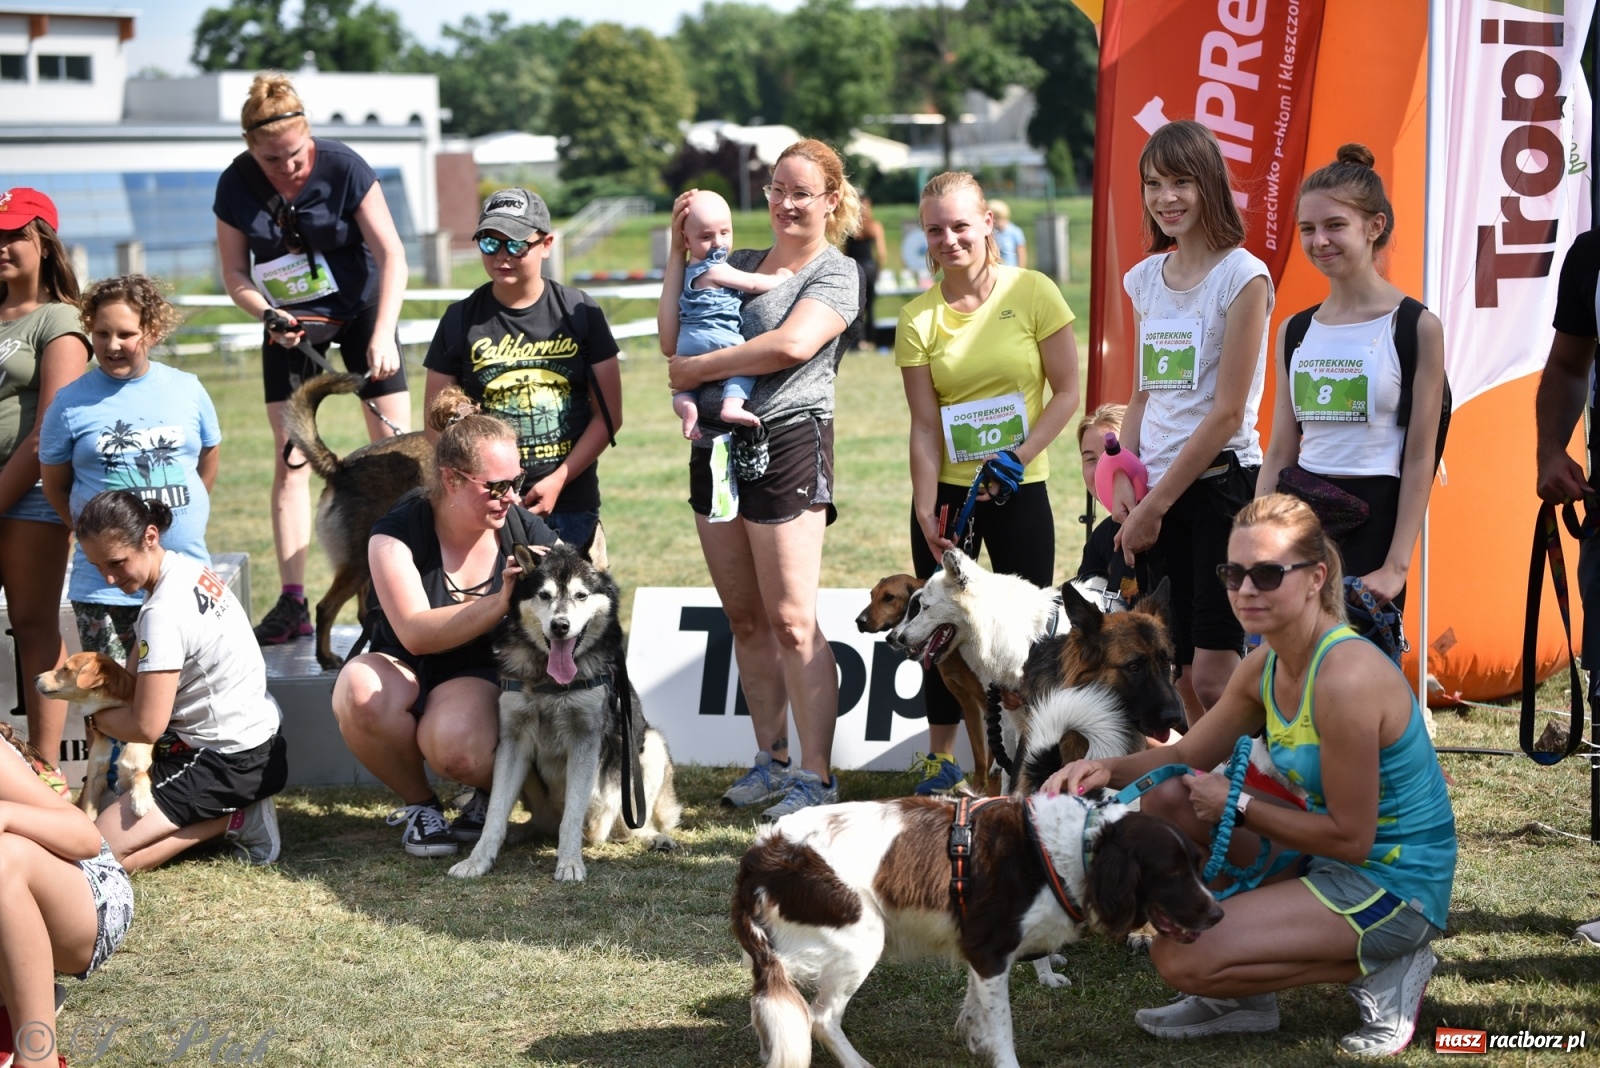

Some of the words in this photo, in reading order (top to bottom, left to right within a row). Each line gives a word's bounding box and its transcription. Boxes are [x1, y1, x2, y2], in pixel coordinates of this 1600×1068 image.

[1195, 0, 1268, 209] IPRe
[1263, 160, 1282, 251] przeciwko
[286, 278, 309, 295] 36
[1146, 331, 1192, 341] DOGTREKKING
[471, 333, 578, 368] California
[522, 359, 574, 379] PARADISE
[1157, 355, 1170, 375] 6
[1298, 359, 1364, 368] DOGTREKKING
[1317, 384, 1333, 405] 8
[954, 404, 1015, 422] DOGTREKKING
[985, 410, 1016, 421] RACIBORZU
[523, 435, 549, 446] TREE
[977, 428, 1002, 447] 10
[534, 440, 572, 458] COAST
